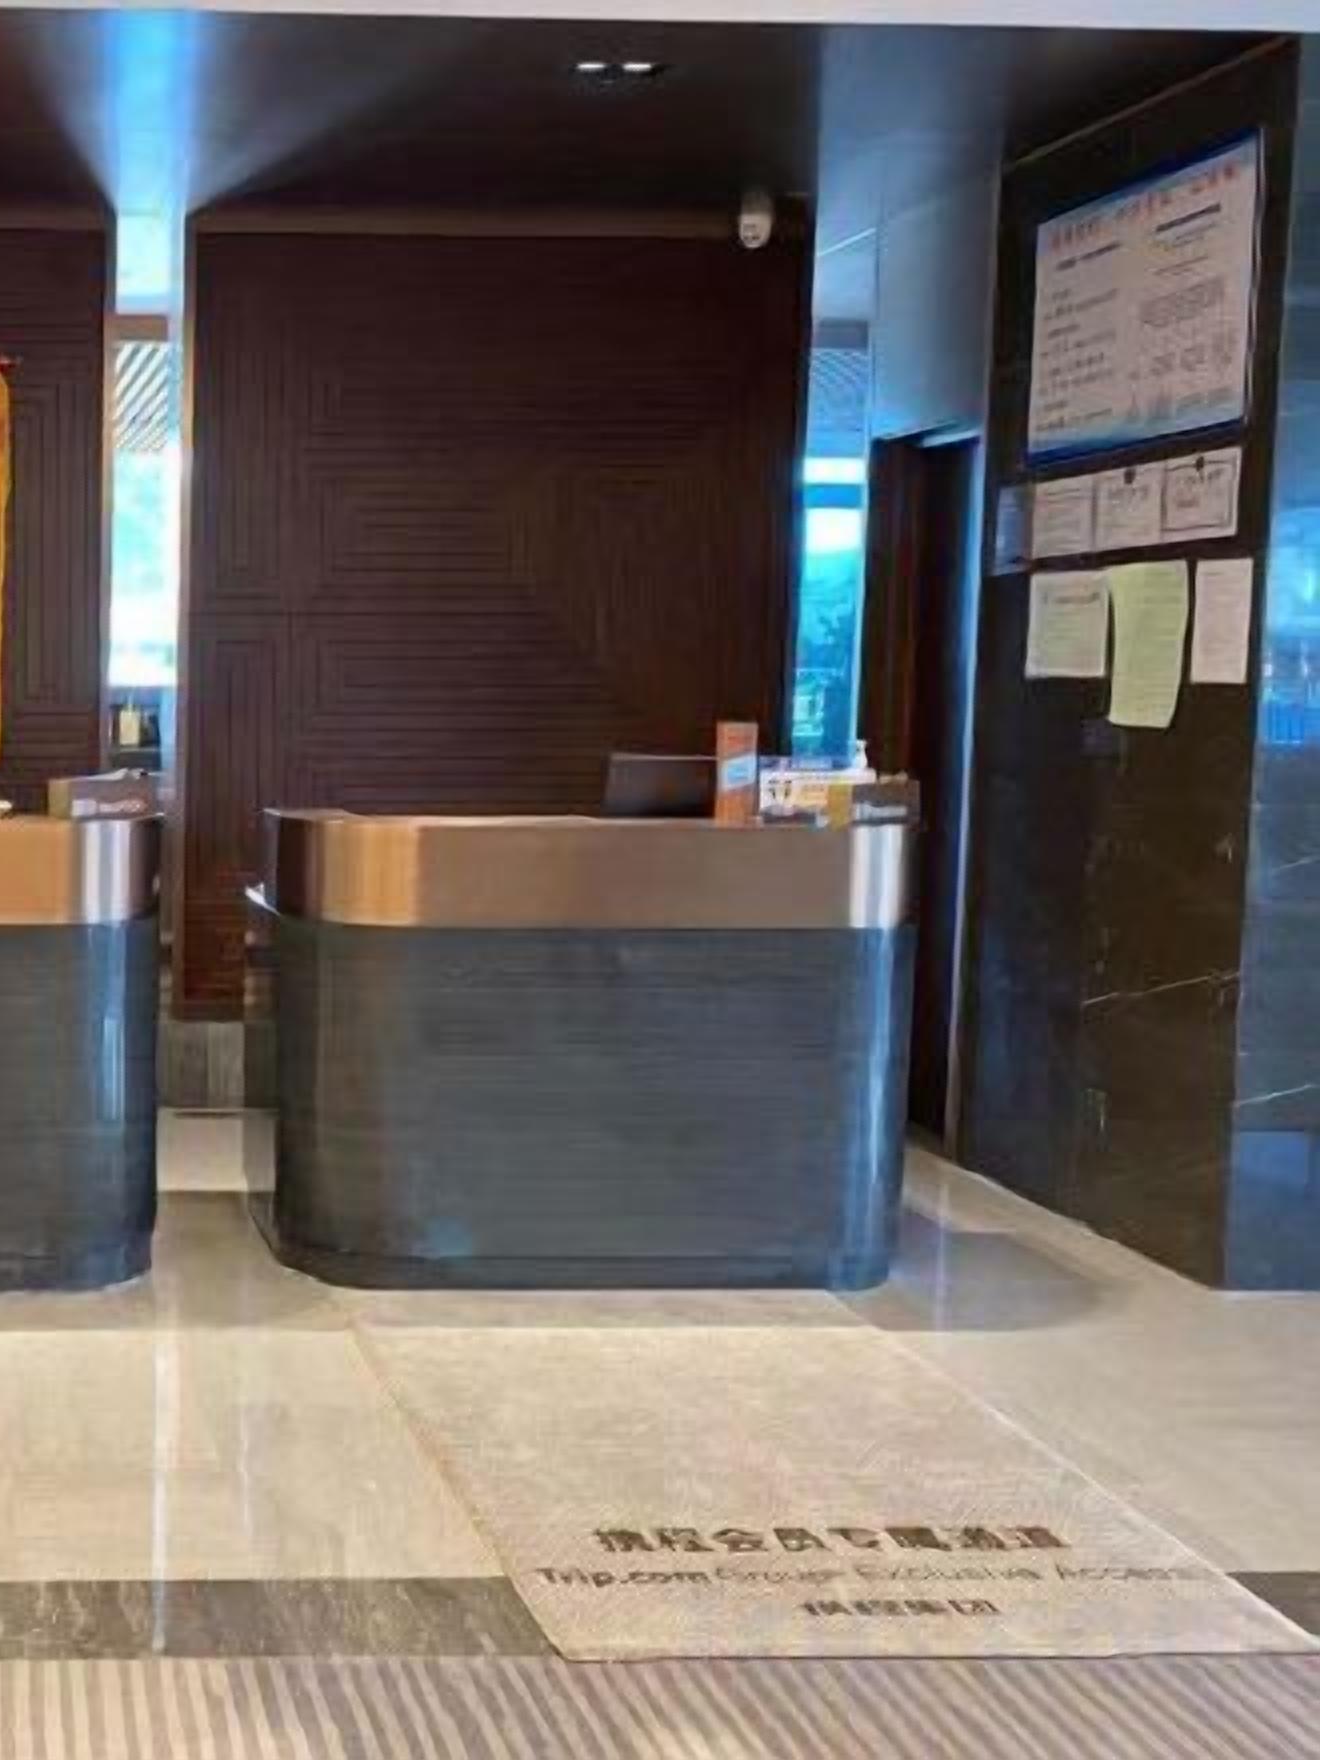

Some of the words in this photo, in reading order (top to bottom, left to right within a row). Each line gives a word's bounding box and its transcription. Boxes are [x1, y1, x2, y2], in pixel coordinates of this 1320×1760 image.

[594, 1526, 1070, 1553] 携程会员专属通道
[534, 1567, 712, 1588] Trip.com
